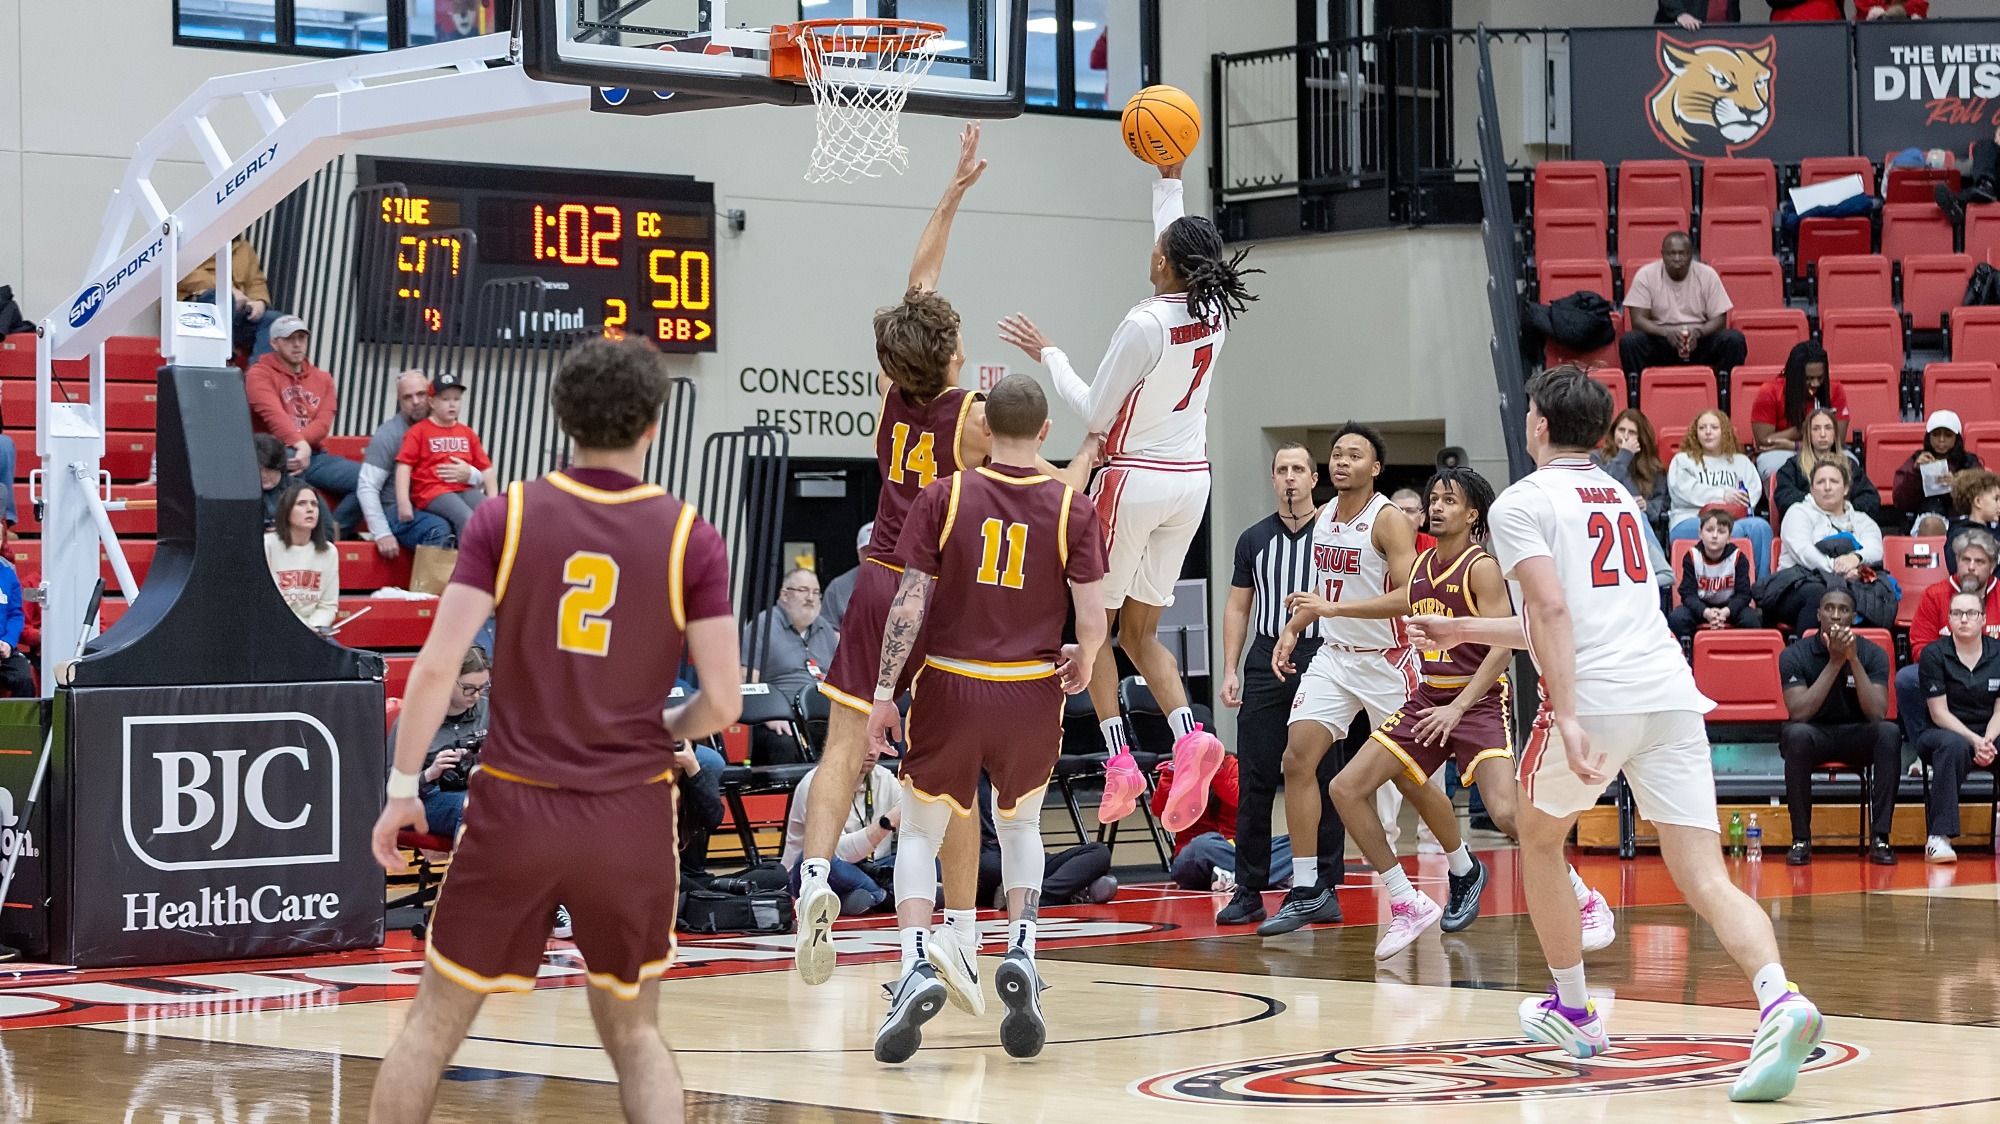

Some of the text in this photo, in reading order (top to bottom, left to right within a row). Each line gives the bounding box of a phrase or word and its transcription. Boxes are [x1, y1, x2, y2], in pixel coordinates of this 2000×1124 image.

[1889, 45, 1935, 65] THE
[1873, 63, 2000, 101] DIVIS
[1924, 96, 1988, 126] Roll
[216, 142, 279, 205] LEGACY
[534, 204, 622, 267] 1:02
[636, 211, 662, 238] EC
[649, 248, 710, 310] 50
[69, 288, 105, 325] SNA
[603, 298, 627, 341] 2
[979, 366, 1005, 391] EXIT
[1172, 343, 1213, 412] 7
[757, 409, 880, 437] RESTROO
[429, 436, 471, 454] SIUE
[888, 421, 937, 488] 14
[976, 517, 1029, 590] 11
[1314, 543, 1362, 577] SIUE
[1587, 511, 1648, 588] 20
[277, 569, 322, 592] SIUE
[1325, 579, 1344, 603] 17
[1697, 575, 1735, 593] SIUE
[557, 550, 620, 657] 2
[152, 746, 312, 851] BJC
[122, 885, 340, 931] HealthCare
